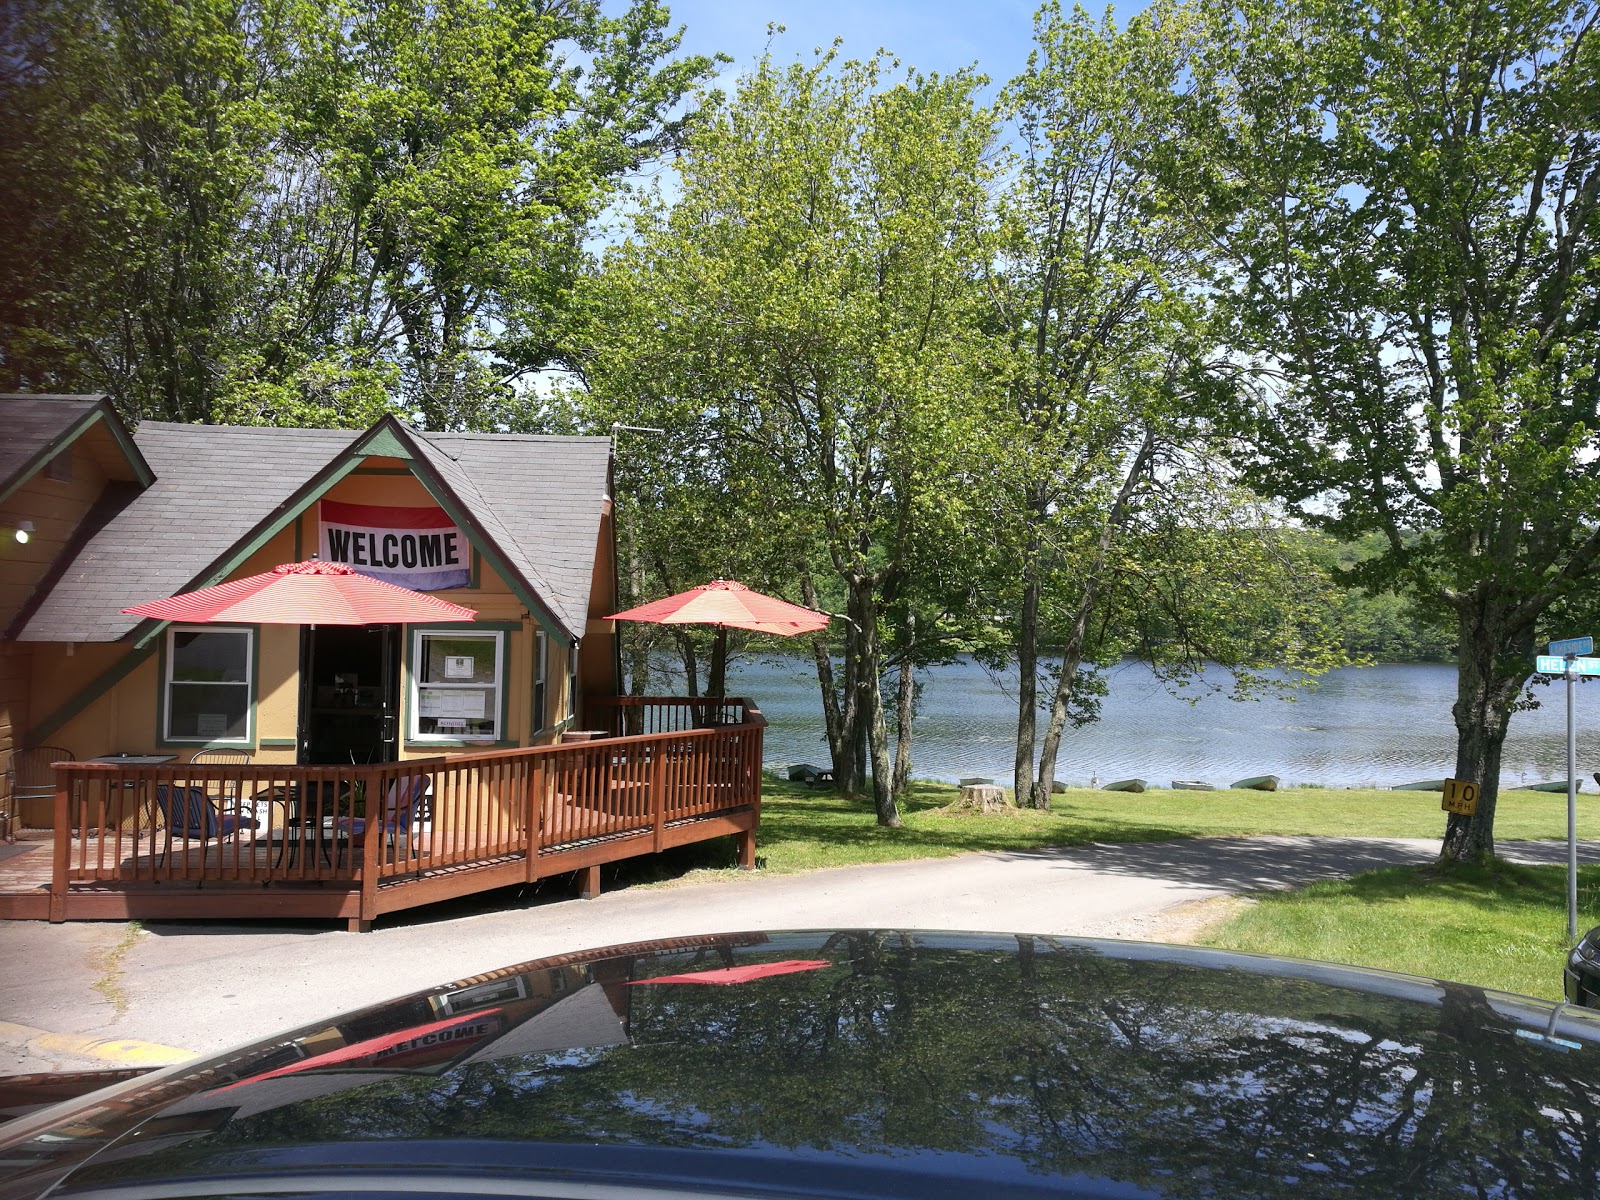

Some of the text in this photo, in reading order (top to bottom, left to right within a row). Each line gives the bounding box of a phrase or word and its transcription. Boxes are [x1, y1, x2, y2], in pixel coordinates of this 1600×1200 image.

[328, 528, 459, 568] WELCOME
[1450, 783, 1475, 802] 10
[1448, 800, 1471, 810] MPH
